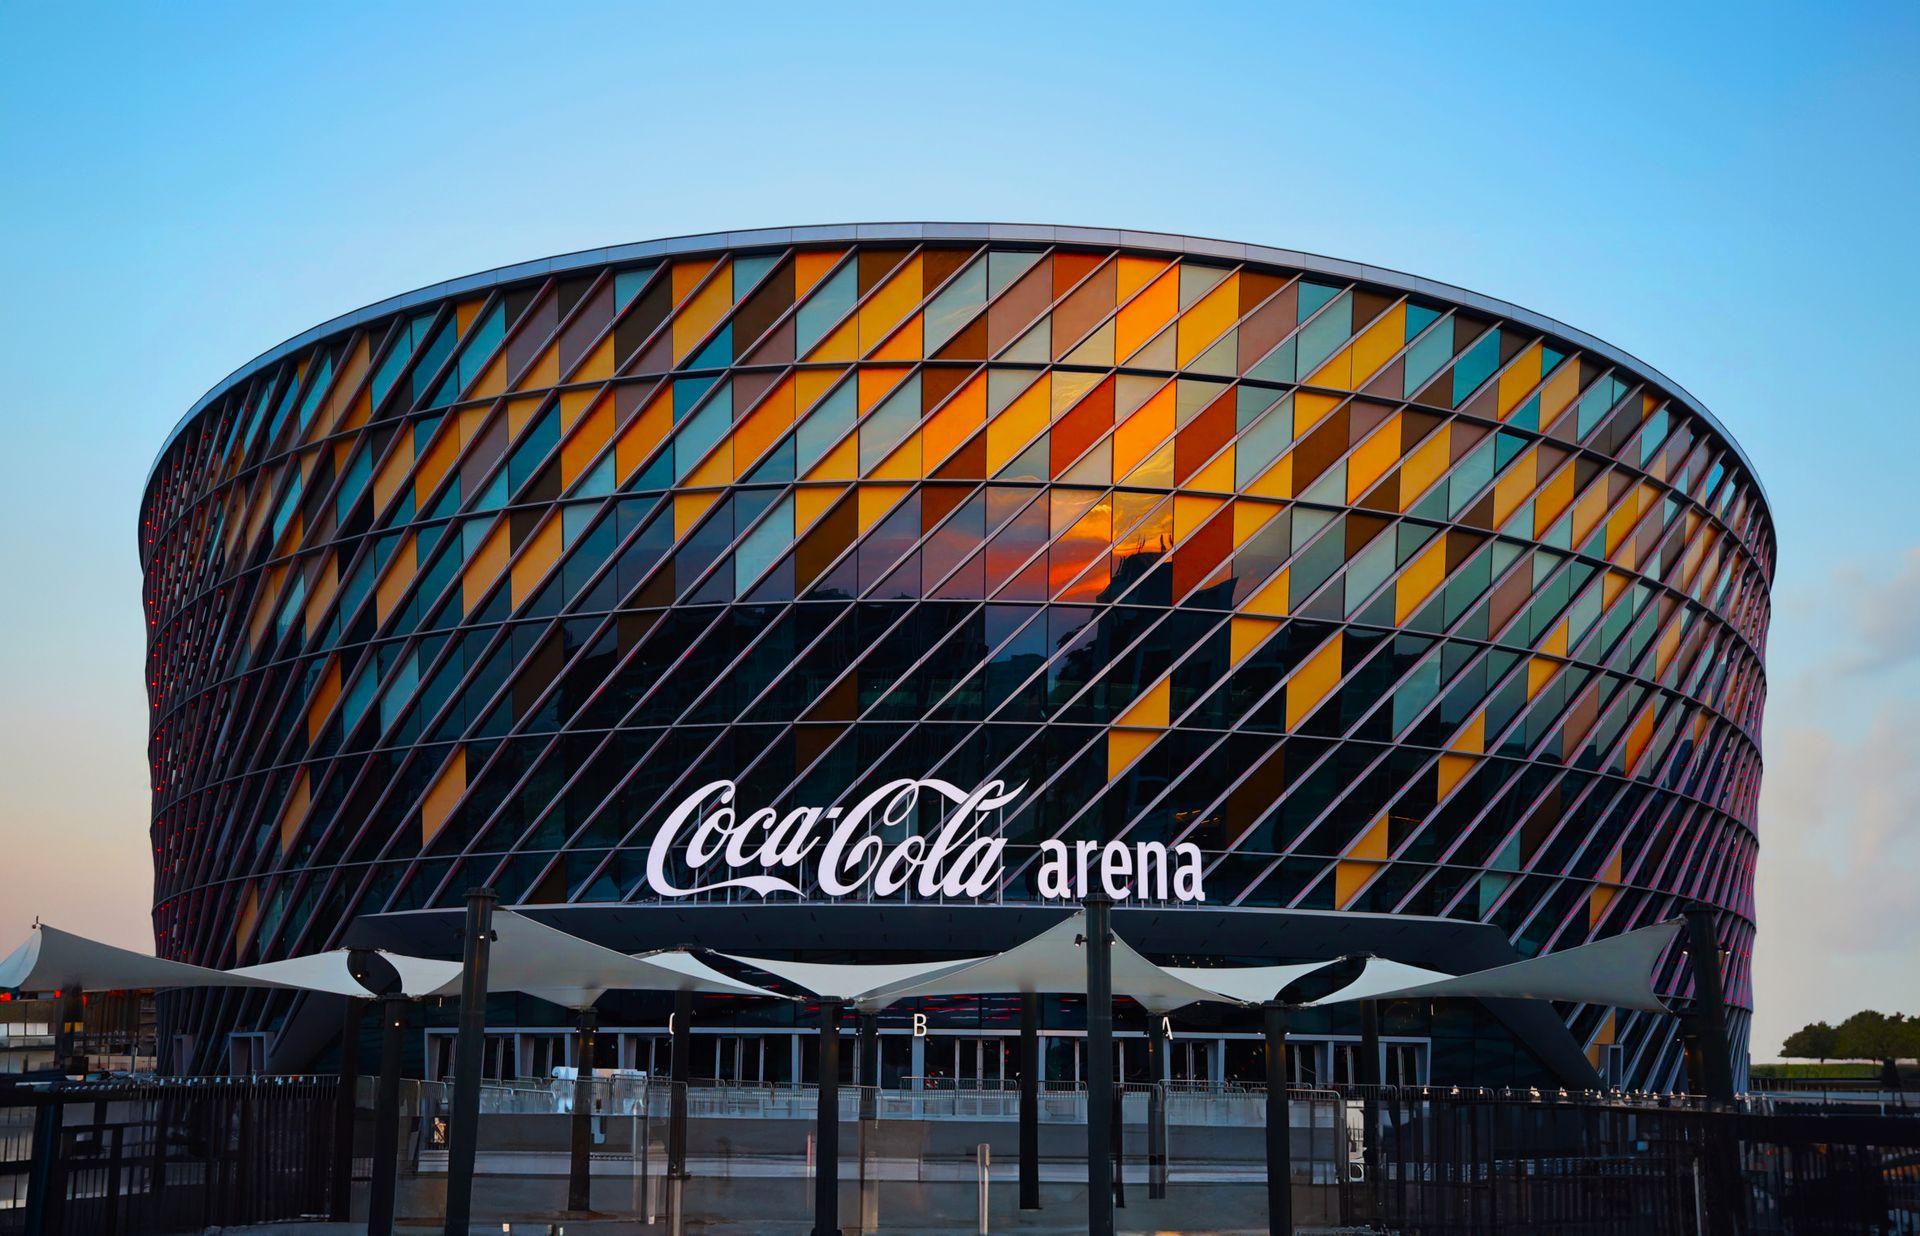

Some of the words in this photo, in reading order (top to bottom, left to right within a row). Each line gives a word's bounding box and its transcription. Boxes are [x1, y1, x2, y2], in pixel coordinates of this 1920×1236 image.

[646, 778, 1029, 898] Coca-Cola
[1037, 839, 1206, 901] arena
[913, 1013, 927, 1037] B
